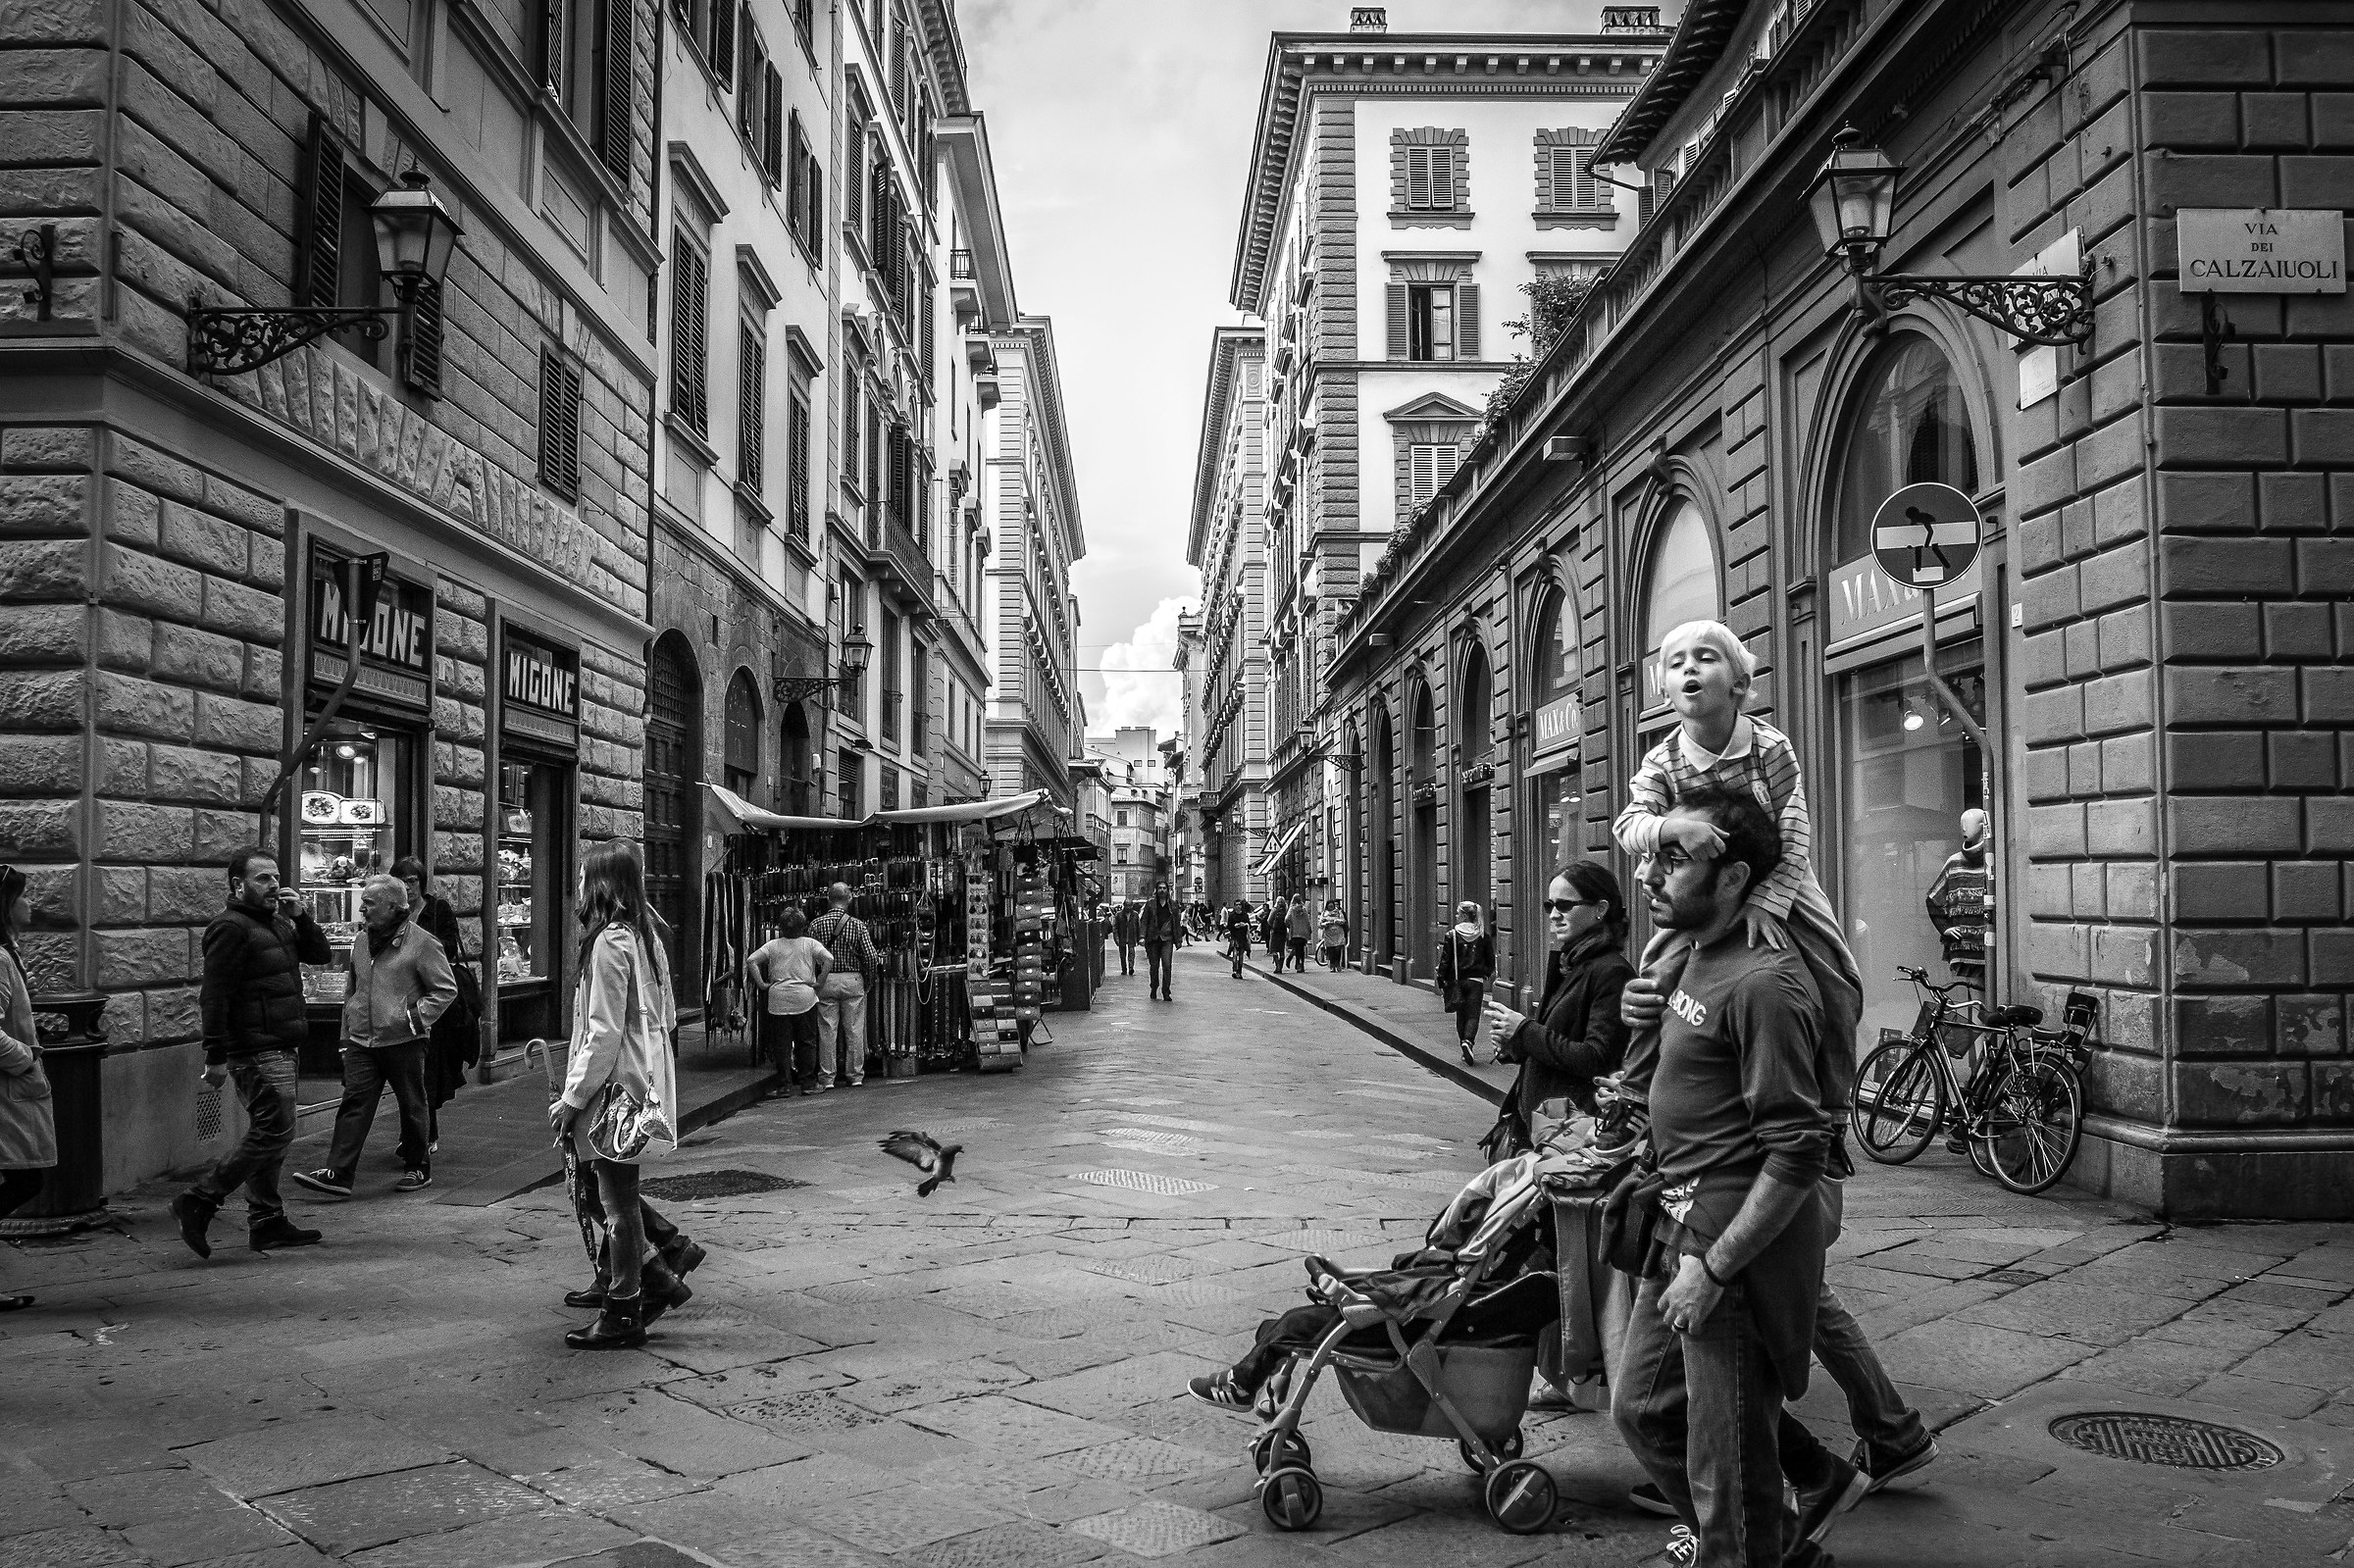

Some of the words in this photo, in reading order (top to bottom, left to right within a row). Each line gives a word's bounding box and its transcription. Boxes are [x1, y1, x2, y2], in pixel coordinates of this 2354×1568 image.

[2244, 223, 2278, 235] VIA
[2251, 242, 2274, 252] DEI
[2189, 259, 2337, 279] CALZAIUOLI
[320, 581, 427, 668] MIONE
[508, 651, 576, 715] MIGONE
